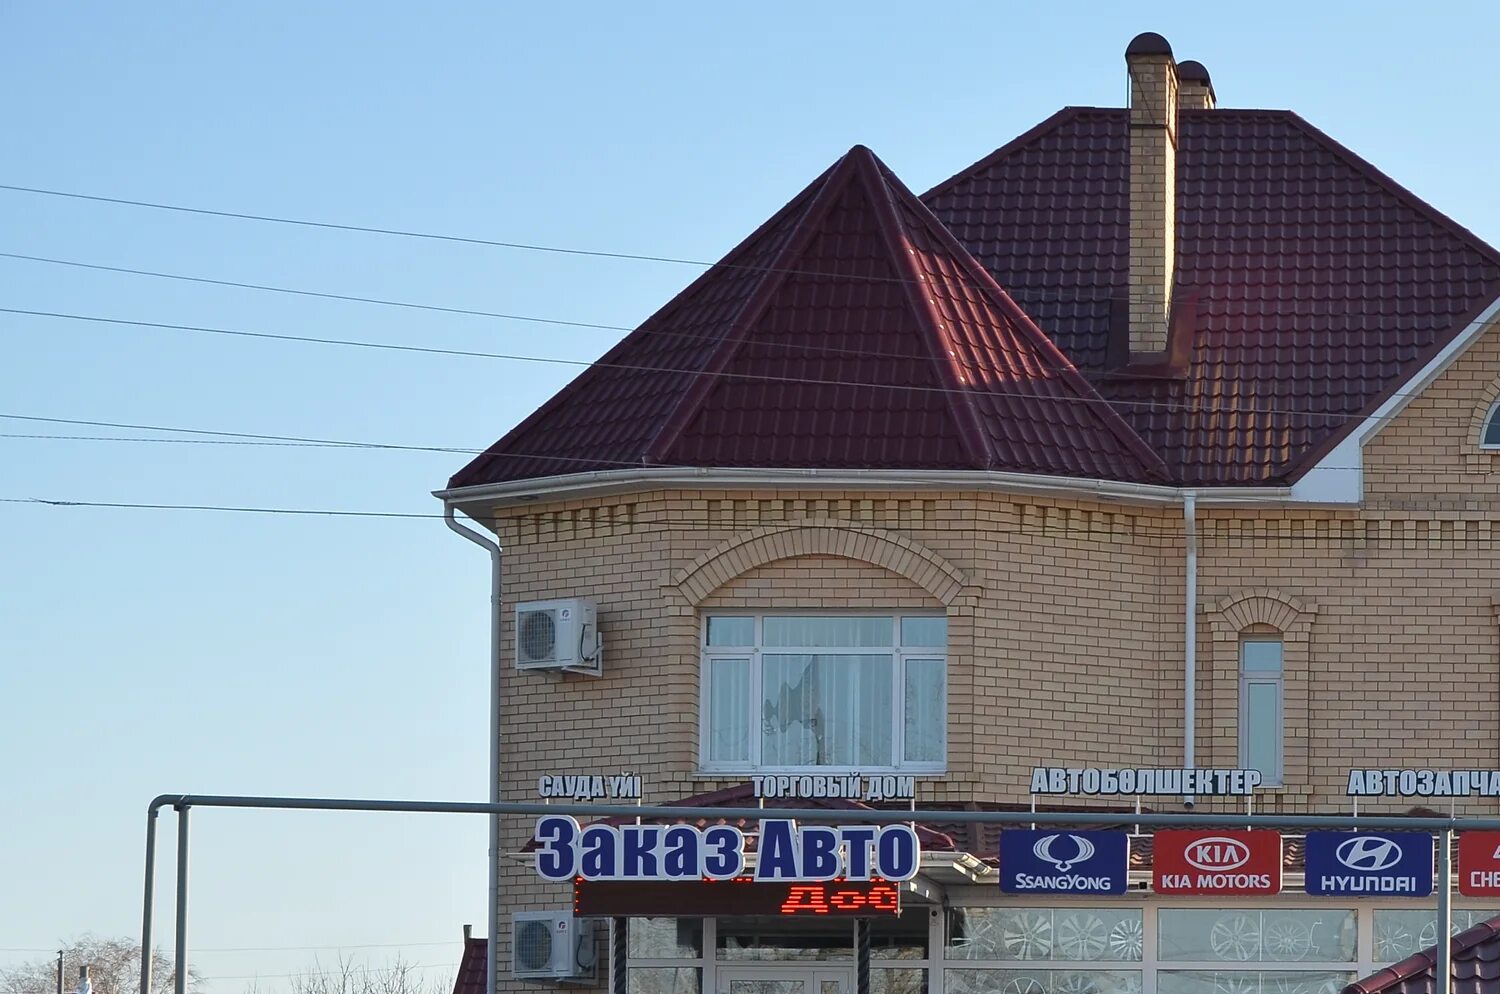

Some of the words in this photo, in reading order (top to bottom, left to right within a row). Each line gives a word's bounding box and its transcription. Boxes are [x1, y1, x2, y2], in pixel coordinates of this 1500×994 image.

[538, 774, 606, 801] САУДА
[752, 771, 861, 799] ТОРГОВЫЙ
[867, 775, 916, 801] ДОМ
[1030, 767, 1262, 796] АВТОБӨЛШЕКТЕР
[1162, 874, 1192, 889] KIA
[1196, 873, 1271, 889] MOTORS
[1321, 875, 1416, 892] HYUNDAI
